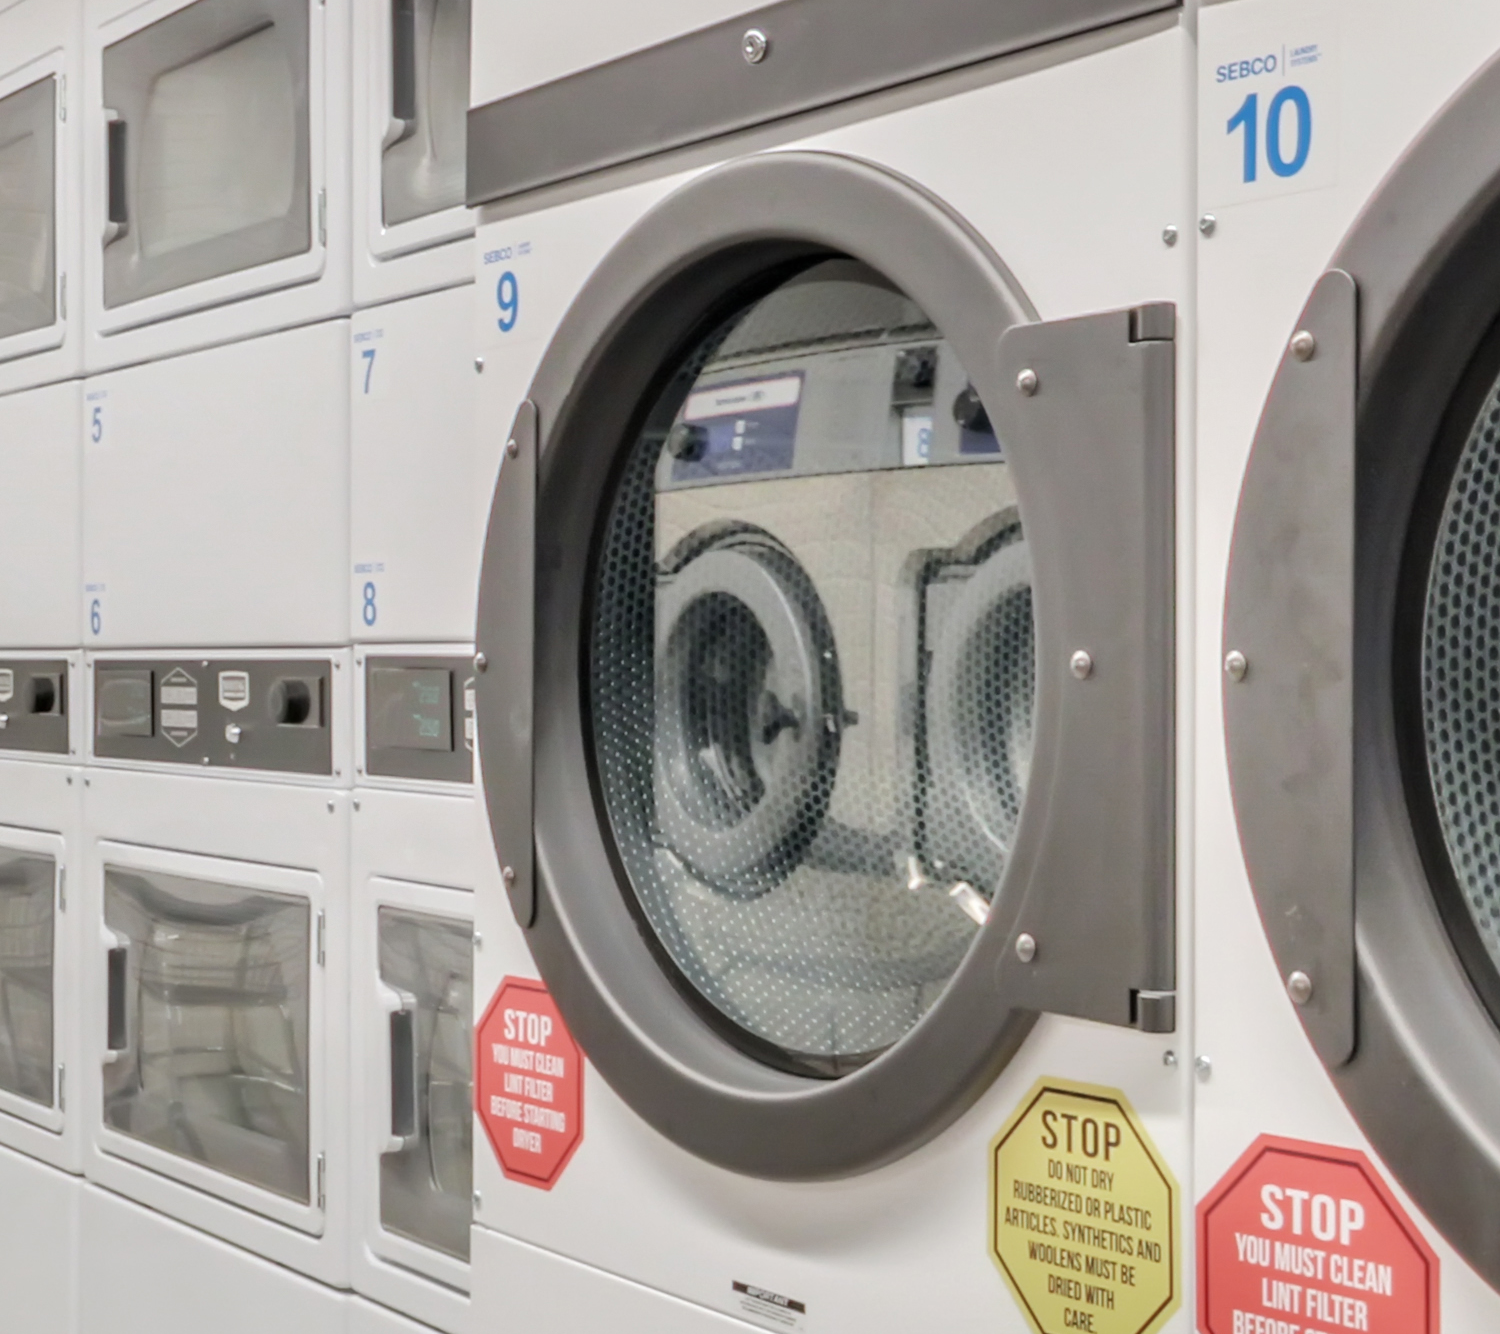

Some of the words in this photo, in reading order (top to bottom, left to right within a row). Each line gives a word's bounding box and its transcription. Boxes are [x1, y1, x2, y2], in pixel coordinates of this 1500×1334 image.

[1215, 54, 1277, 83] SEBCO
[1226, 85, 1312, 183] 10
[484, 247, 512, 265] SEBCO
[496, 270, 519, 332] 9
[362, 348, 376, 394] 7
[91, 406, 102, 443] 5
[90, 598, 101, 635] 6
[363, 582, 377, 626] 8
[504, 1008, 552, 1047] STOP
[492, 1043, 509, 1065] YOU
[510, 1047, 535, 1071] MUST
[535, 1052, 564, 1078] CLEAN
[504, 1072, 523, 1095] LINT
[524, 1076, 553, 1103] FILTER
[490, 1095, 522, 1122] BEFORE
[524, 1103, 565, 1133] STARTING
[513, 1127, 542, 1154] DRYER
[1041, 1110, 1120, 1161] STOP
[1048, 1159, 1061, 1180] DO
[1066, 1163, 1088, 1186] NOT
[1091, 1169, 1114, 1192] DRY
[1013, 1179, 1082, 1214] RUBBERIZED
[1085, 1196, 1100, 1217] OR
[1104, 1201, 1151, 1230] PLASTIC
[1260, 1184, 1365, 1246] STOP
[1005, 1206, 1059, 1237] ARTICLES.
[1063, 1221, 1133, 1256] SYNTHETICS
[1137, 1240, 1161, 1263] AND
[1028, 1241, 1081, 1272] WOOLENS
[1085, 1255, 1117, 1281] MUST
[1121, 1266, 1136, 1287] BE
[1235, 1232, 1270, 1267] YOU
[1274, 1241, 1326, 1280] MUST
[1330, 1253, 1392, 1296] CLEAN
[1048, 1274, 1081, 1301] DRIED
[1085, 1284, 1114, 1310] WITH
[1262, 1277, 1302, 1314] LINT
[1306, 1288, 1368, 1332] FILTER
[1064, 1307, 1097, 1334] CARE.
